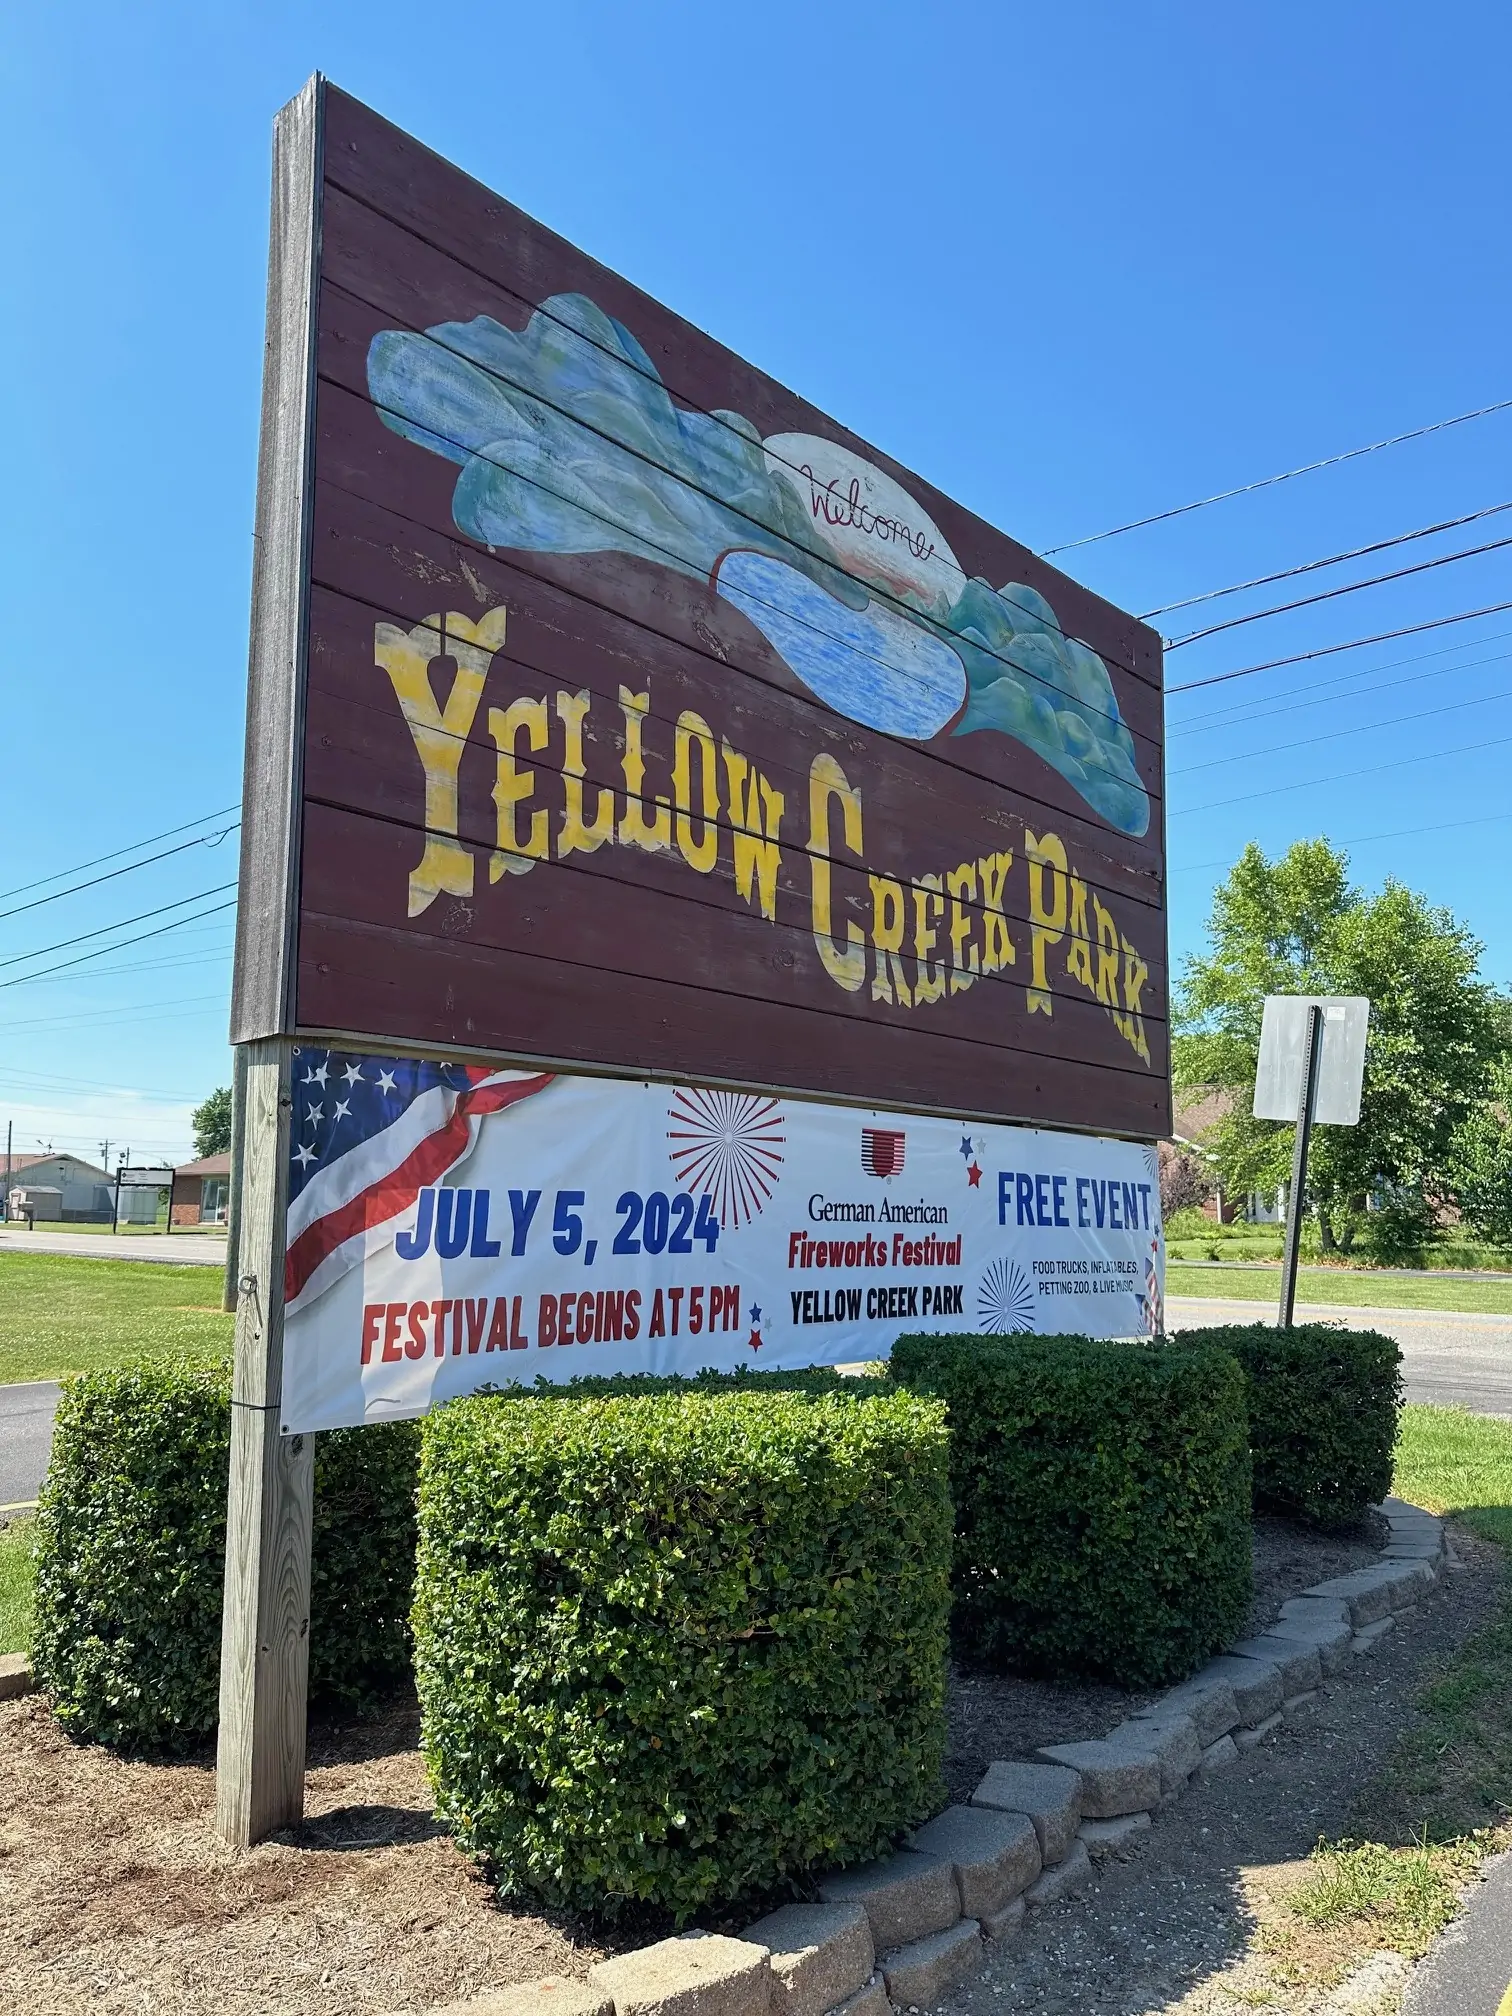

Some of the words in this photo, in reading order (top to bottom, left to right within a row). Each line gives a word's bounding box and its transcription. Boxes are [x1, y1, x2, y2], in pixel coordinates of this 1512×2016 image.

[801, 464, 935, 561] Welcome
[374, 605, 785, 927] YELLOW
[805, 753, 1016, 1009] CREEK
[1025, 828, 1150, 1068] PARK
[808, 1193, 875, 1224] German
[878, 1197, 949, 1224] American
[998, 1172, 1069, 1226] FREE
[1076, 1178, 1151, 1230] EVENT
[396, 1188, 542, 1260] JULY
[552, 1191, 598, 1266] 5,
[612, 1191, 720, 1255] 2024
[788, 1230, 887, 1269] Fireworks
[892, 1232, 962, 1267] Festival
[1032, 1261, 1055, 1274] FOOD
[1057, 1260, 1090, 1275] TRUCKS,
[1038, 1280, 1071, 1295] PETTING
[1073, 1280, 1090, 1295] ZOO,
[1092, 1281, 1098, 1294] &
[1100, 1280, 1115, 1293] LIVE
[1116, 1279, 1133, 1292] MUSIC
[360, 1295, 529, 1366] FESTIVAL
[537, 1290, 641, 1349] BEGINS
[648, 1288, 684, 1339] AT
[689, 1286, 703, 1335] 5
[708, 1284, 741, 1333] PM
[790, 1289, 862, 1325] YELLOW
[867, 1286, 918, 1319] CREEK
[922, 1284, 964, 1317] PARK
